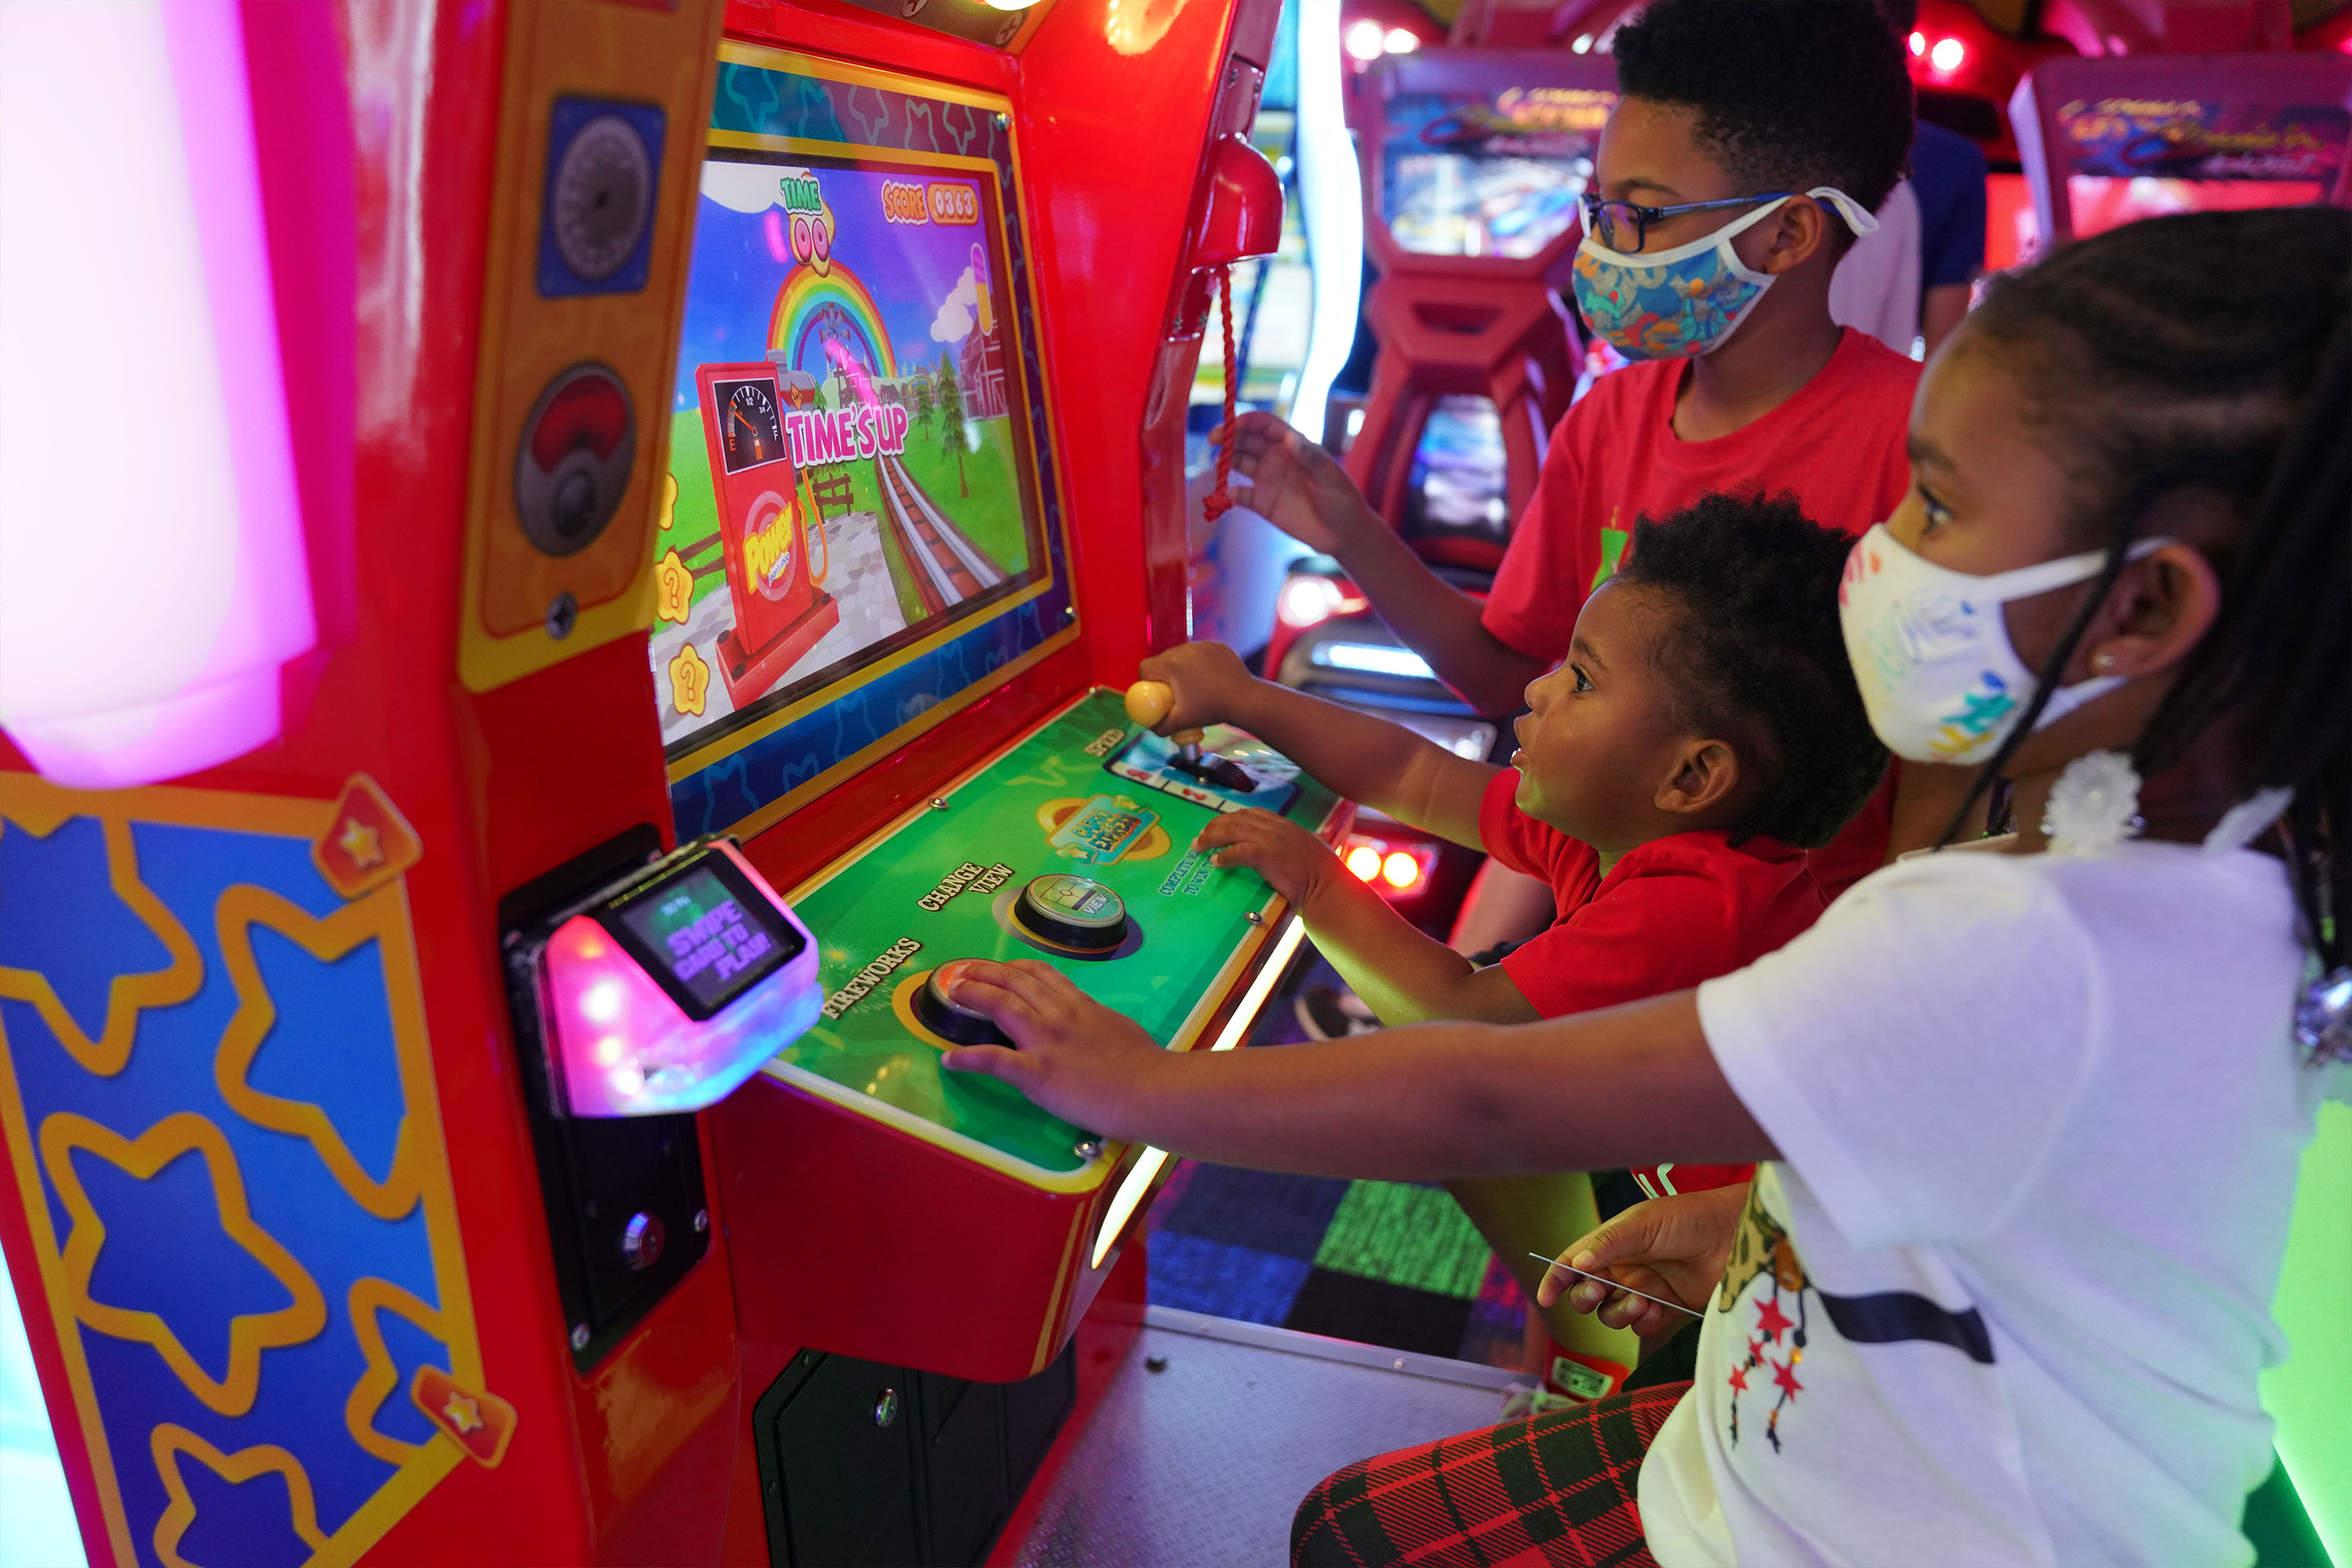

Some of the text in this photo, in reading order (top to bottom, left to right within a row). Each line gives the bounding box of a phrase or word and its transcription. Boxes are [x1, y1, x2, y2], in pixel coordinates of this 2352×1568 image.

[780, 176, 823, 214] TIME
[882, 180, 974, 223] SCORE 0363
[786, 403, 910, 467] TIME'S UP
[915, 862, 987, 911] CHANGE
[967, 862, 1015, 894] VIEW
[1158, 858, 1194, 896] COMPLETE
[1183, 884, 1200, 895] TO
[1191, 867, 1210, 884] WIN
[1082, 892, 1110, 915] VIEW
[666, 899, 743, 957] SWIPE
[822, 937, 923, 1020] FIREWORKS
